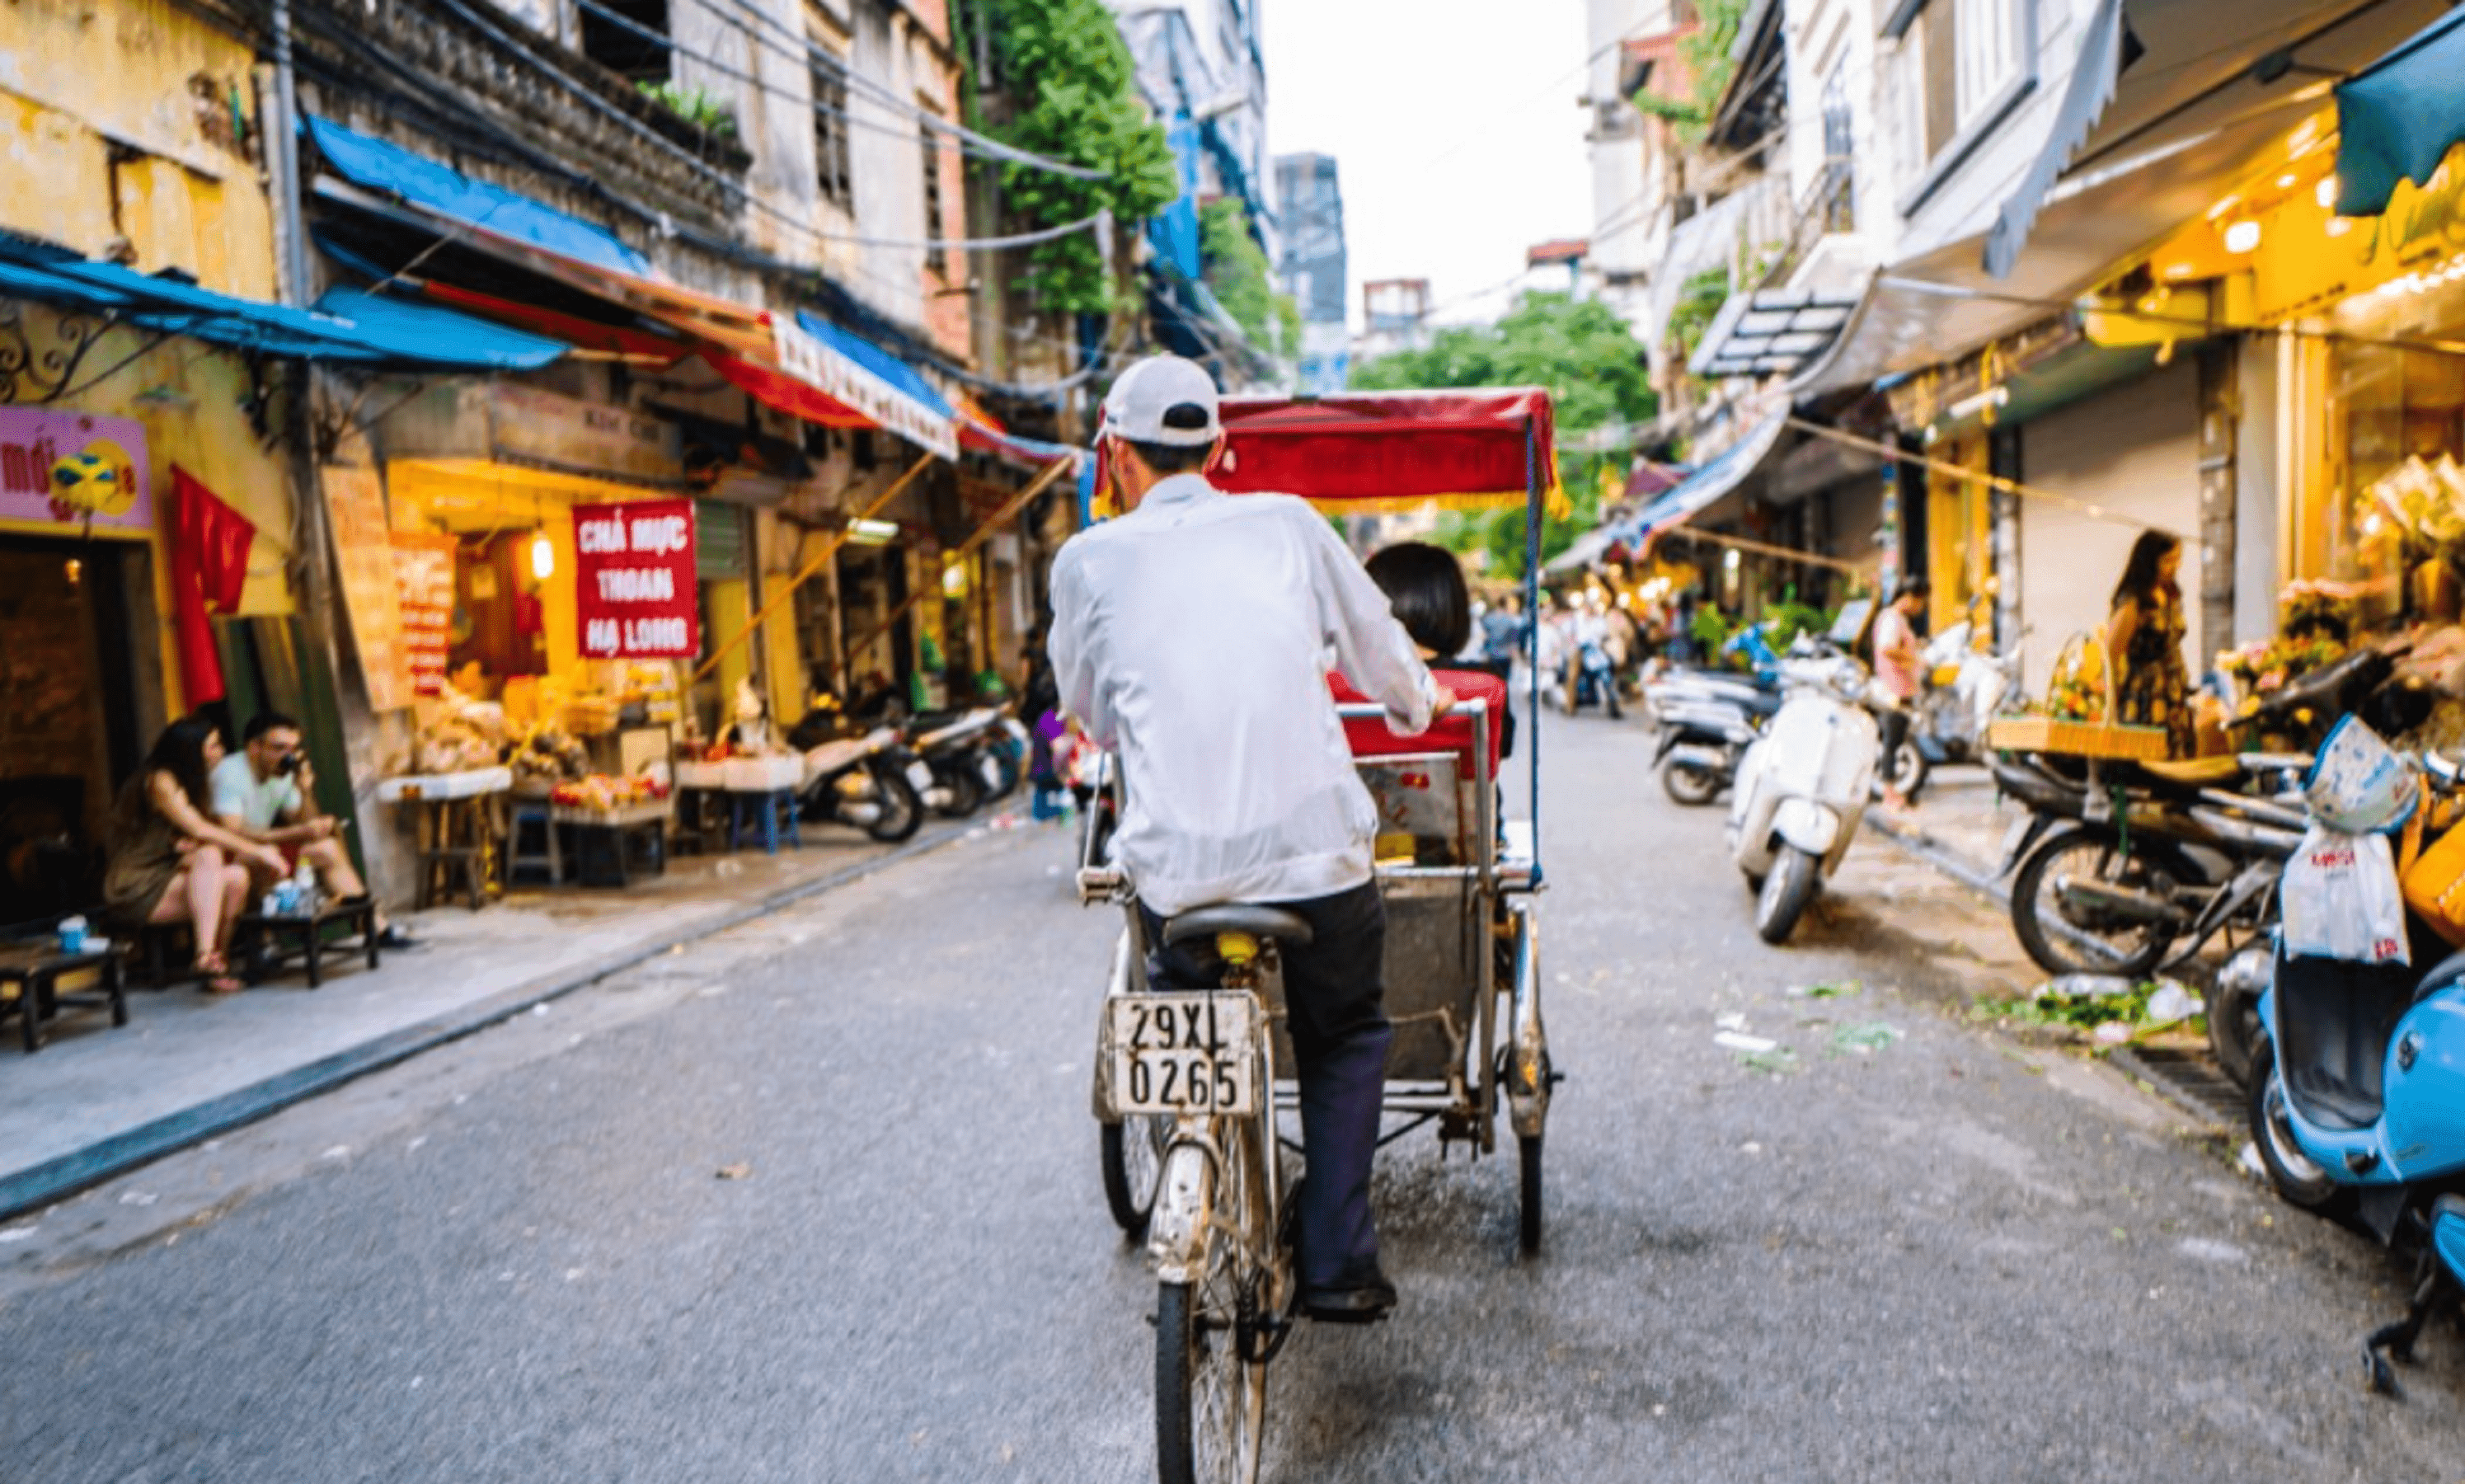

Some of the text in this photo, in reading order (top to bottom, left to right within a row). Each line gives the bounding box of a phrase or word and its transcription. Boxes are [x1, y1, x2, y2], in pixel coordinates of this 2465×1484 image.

[587, 617, 688, 659] HẠ LONG
[1130, 1003, 1228, 1051] 29XL
[1129, 1059, 1237, 1107] 0265
